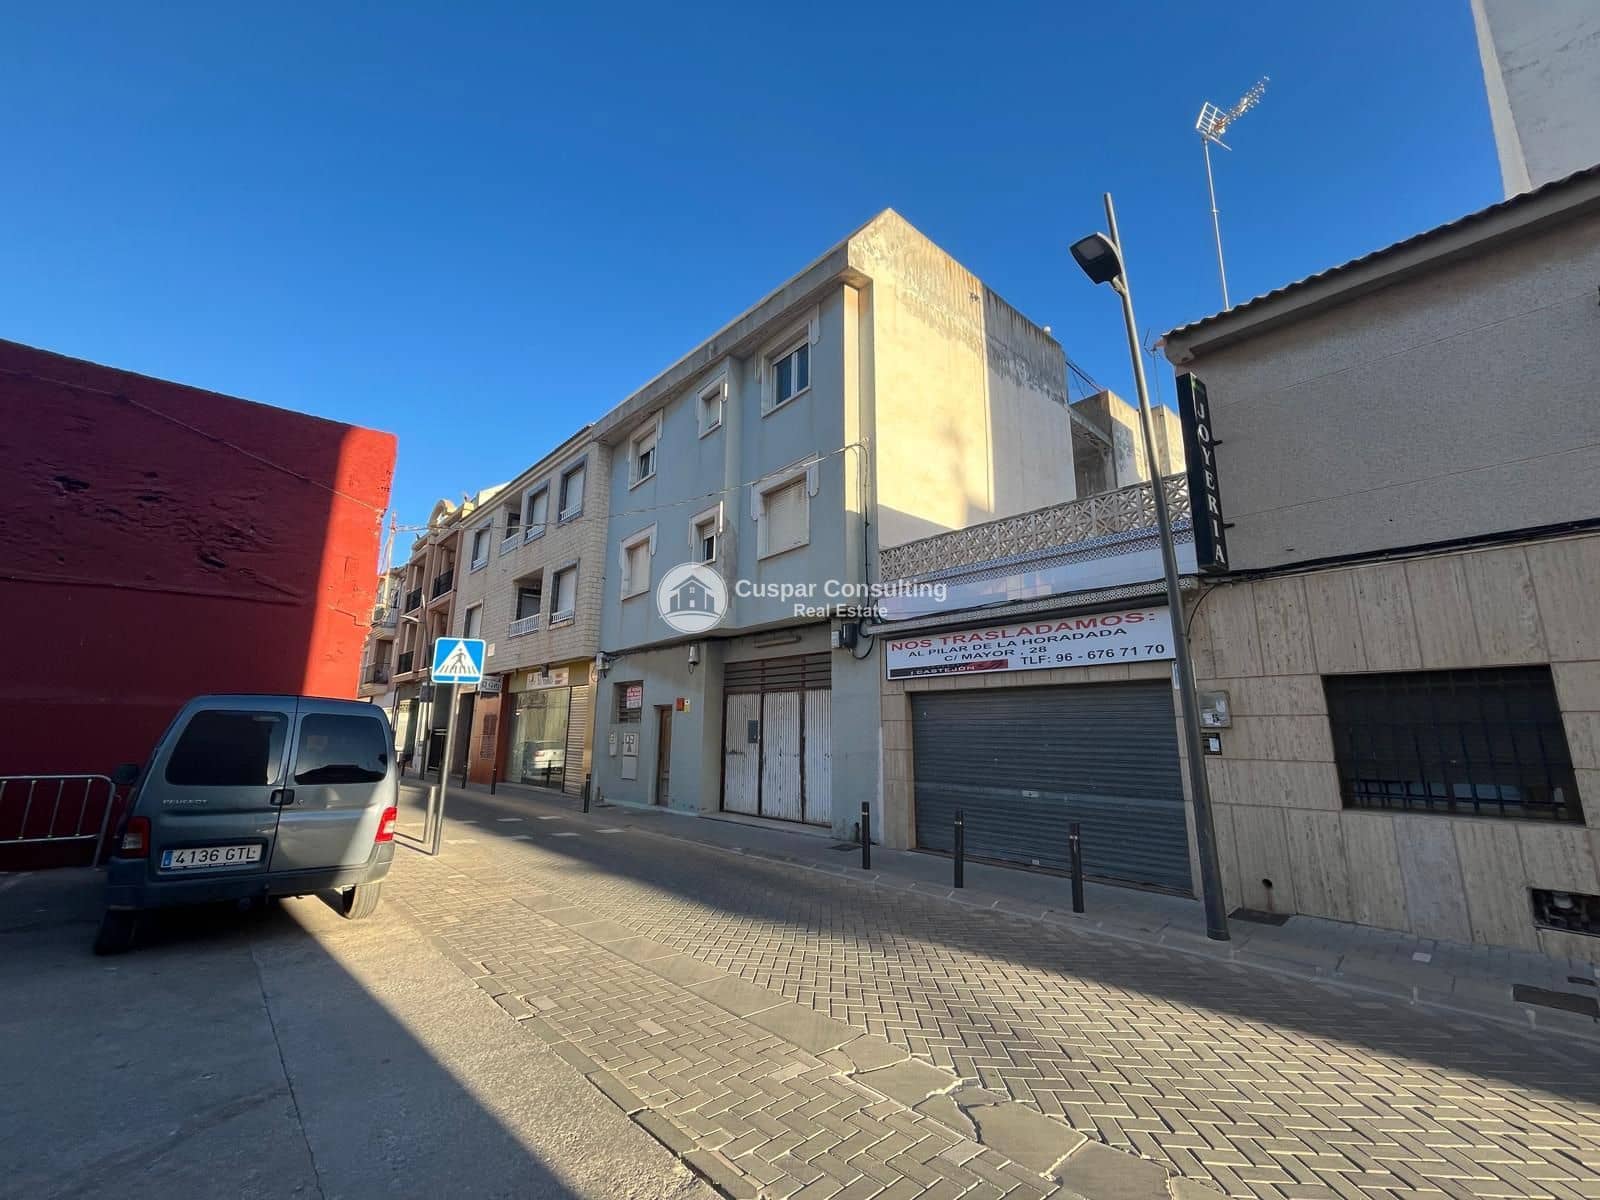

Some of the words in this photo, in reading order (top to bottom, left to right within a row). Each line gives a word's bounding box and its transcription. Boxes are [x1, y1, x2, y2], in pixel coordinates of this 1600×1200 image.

[1197, 402, 1226, 565] JOYERIA
[891, 639, 932, 652] NOS
[939, 612, 1156, 646] TRASLADAMOS:
[908, 650, 925, 658] AL
[928, 644, 969, 656] PILAR
[973, 643, 993, 651] DE
[997, 639, 1017, 648] LA
[1022, 627, 1128, 647] HORADADA
[944, 654, 959, 662] C/
[961, 649, 1015, 661] MAYOR
[1029, 645, 1048, 654] 28
[1021, 655, 1051, 666] TLF:
[1056, 653, 1073, 663] 96
[1087, 648, 1115, 660] 676
[1120, 646, 1138, 655] 71
[1144, 643, 1166, 655] 70
[175, 848, 220, 864] 4136
[225, 847, 257, 861] GTL
